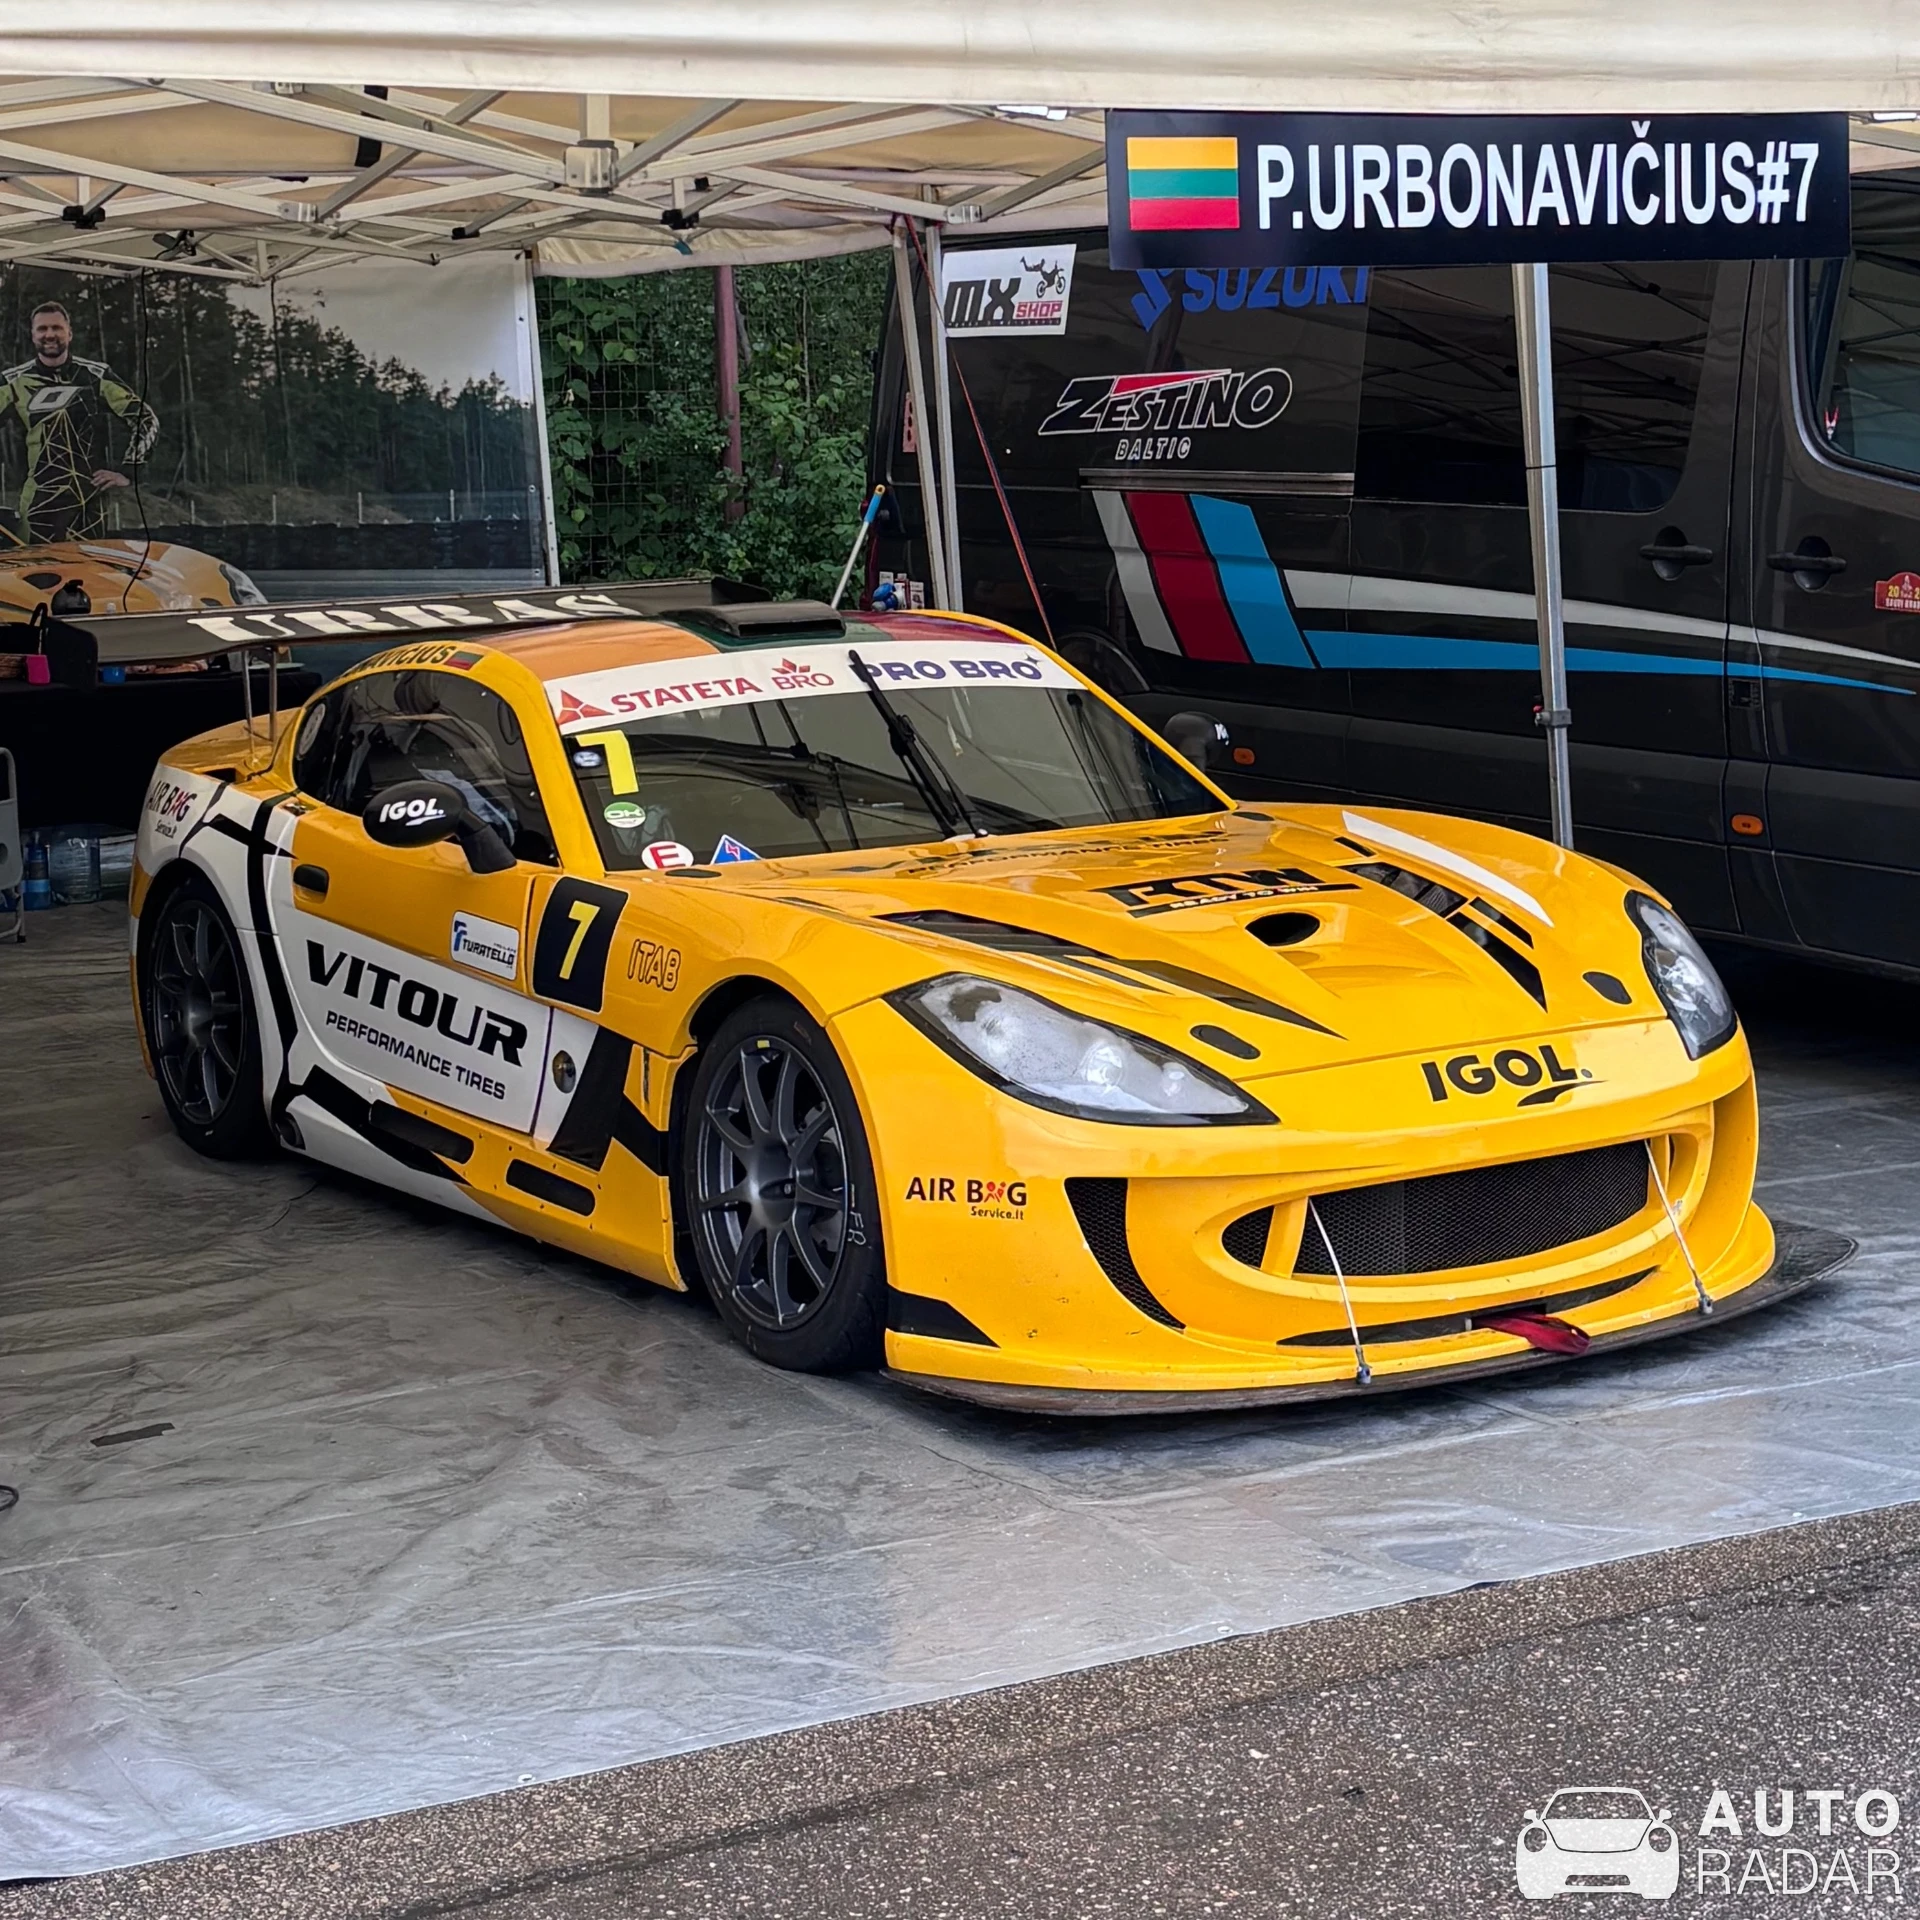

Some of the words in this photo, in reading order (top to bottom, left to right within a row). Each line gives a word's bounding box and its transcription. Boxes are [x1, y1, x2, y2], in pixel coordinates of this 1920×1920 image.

[1257, 121, 1819, 230] P.URBONAVIČIUS#7
[1015, 301, 1062, 318] SHOP
[1038, 368, 1293, 435] ZESTINO
[1115, 437, 1192, 460] BALTIC
[611, 677, 763, 712] STATETA
[772, 673, 834, 690] BRO
[949, 660, 1042, 680] BRO
[576, 730, 639, 795] 7
[649, 844, 686, 869] E
[561, 900, 600, 980] 7
[627, 939, 682, 992] ITAB
[306, 939, 528, 1068] VITOUR
[325, 1010, 453, 1077] PERFORMANCE
[456, 1065, 506, 1100] TIRES
[906, 1177, 957, 1203] AIR
